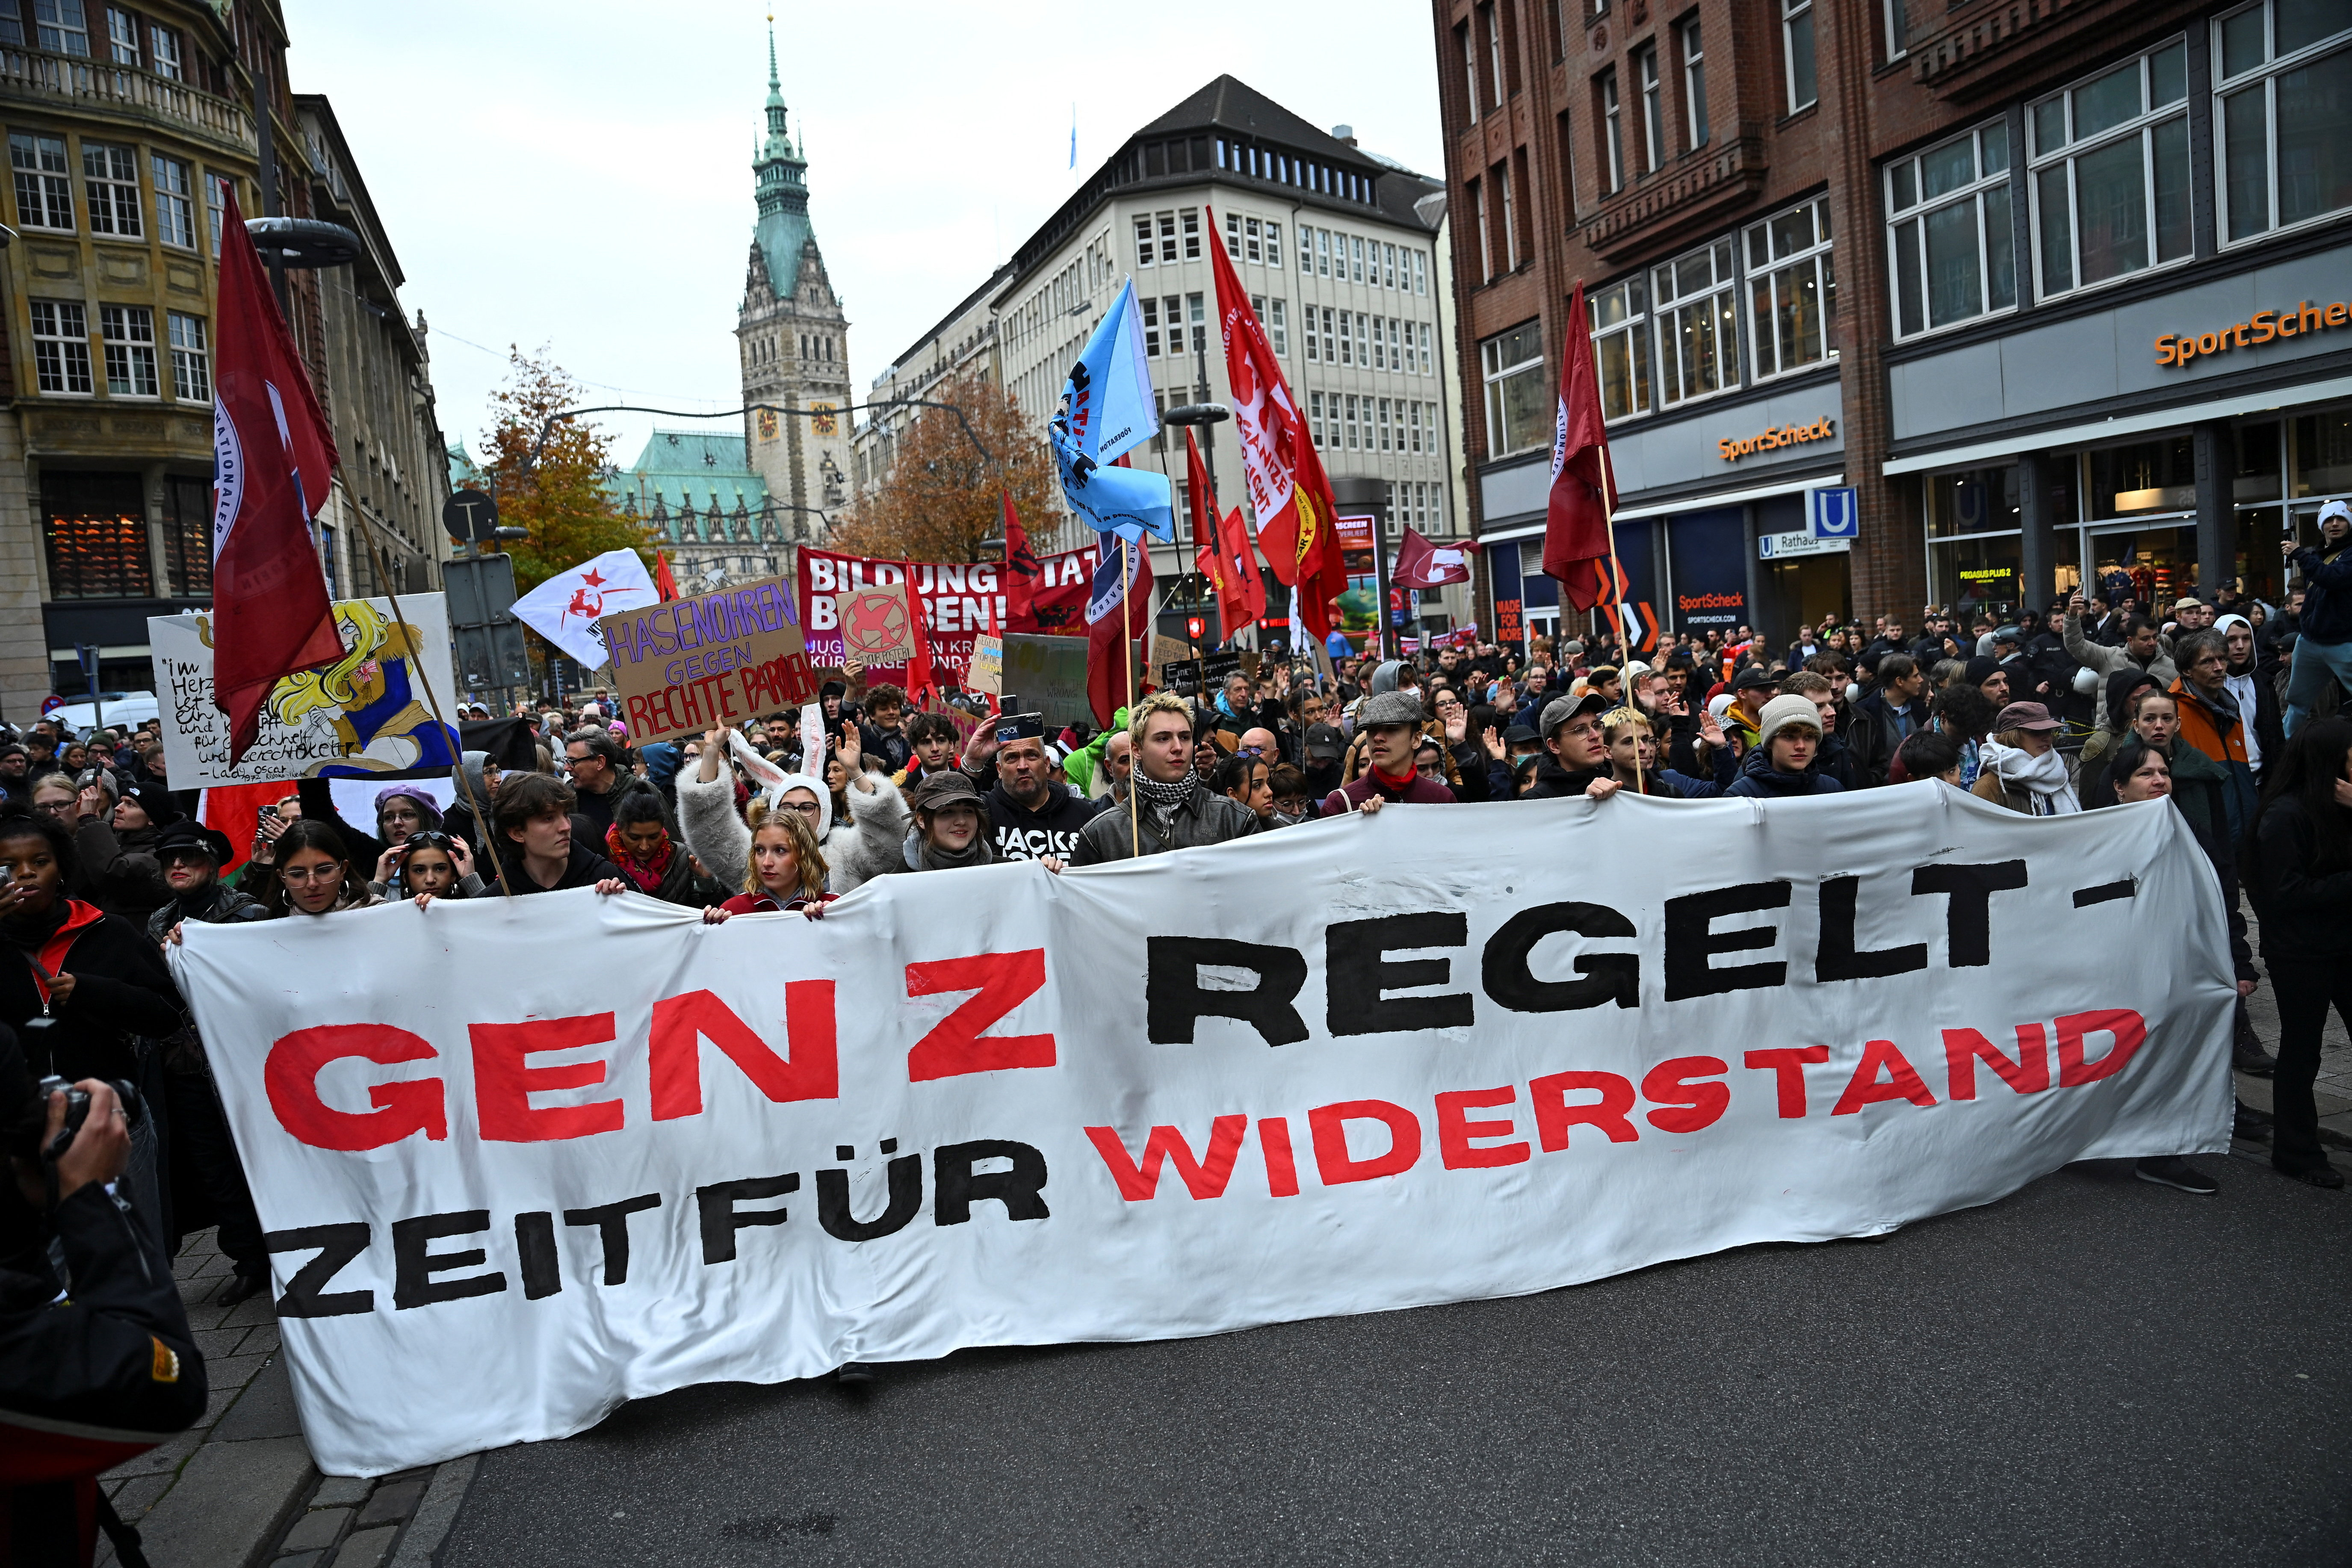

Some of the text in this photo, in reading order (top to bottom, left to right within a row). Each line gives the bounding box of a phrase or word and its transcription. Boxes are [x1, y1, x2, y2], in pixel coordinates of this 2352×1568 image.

[2154, 300, 2352, 366] SportSche
[1552, 408, 1566, 475] NATIONALER
[1718, 416, 1832, 461] SportScheck
[1236, 411, 1287, 496] RGANIZE
[215, 410, 234, 534] NATIONALER
[1076, 499, 1086, 511] DER
[1113, 513, 1160, 530] DEUTSCHLAND
[1820, 492, 1850, 533] U
[1761, 534, 1818, 556] U Rathaus
[810, 557, 998, 594] BILDUNG
[1960, 568, 2011, 579] PEGASUS PLUS 2
[1496, 599, 1521, 614] MADE
[1678, 592, 1743, 613] SportScheck
[2002, 604, 2007, 613] 2
[607, 579, 798, 668] HASENOHREN
[1501, 614, 1518, 627] FOR
[1687, 615, 1736, 624] SPORTSCHECK.COM
[977, 635, 999, 649] GEGEN
[1158, 640, 1169, 649] WE
[1498, 627, 1523, 642] MORE
[665, 642, 752, 685] GEGEN
[864, 653, 882, 664] YOUR
[882, 647, 910, 662] POSTER!
[975, 652, 1000, 665] FÜR DIE
[1155, 648, 1186, 660] FEED THE
[627, 671, 738, 738] RECHTE
[740, 649, 818, 713] PAROLEN
[1047, 688, 1078, 698] WRONG
[1019, 697, 1096, 726] ENERATION
[194, 735, 219, 750] für
[242, 774, 261, 782] 1972
[996, 826, 1069, 854] JACK
[264, 979, 839, 1152] GEN
[905, 947, 1056, 1083] Z
[1146, 859, 2028, 1047] REGELT
[264, 1007, 2147, 1318] ZEIT FÜR WIDERSTAND
